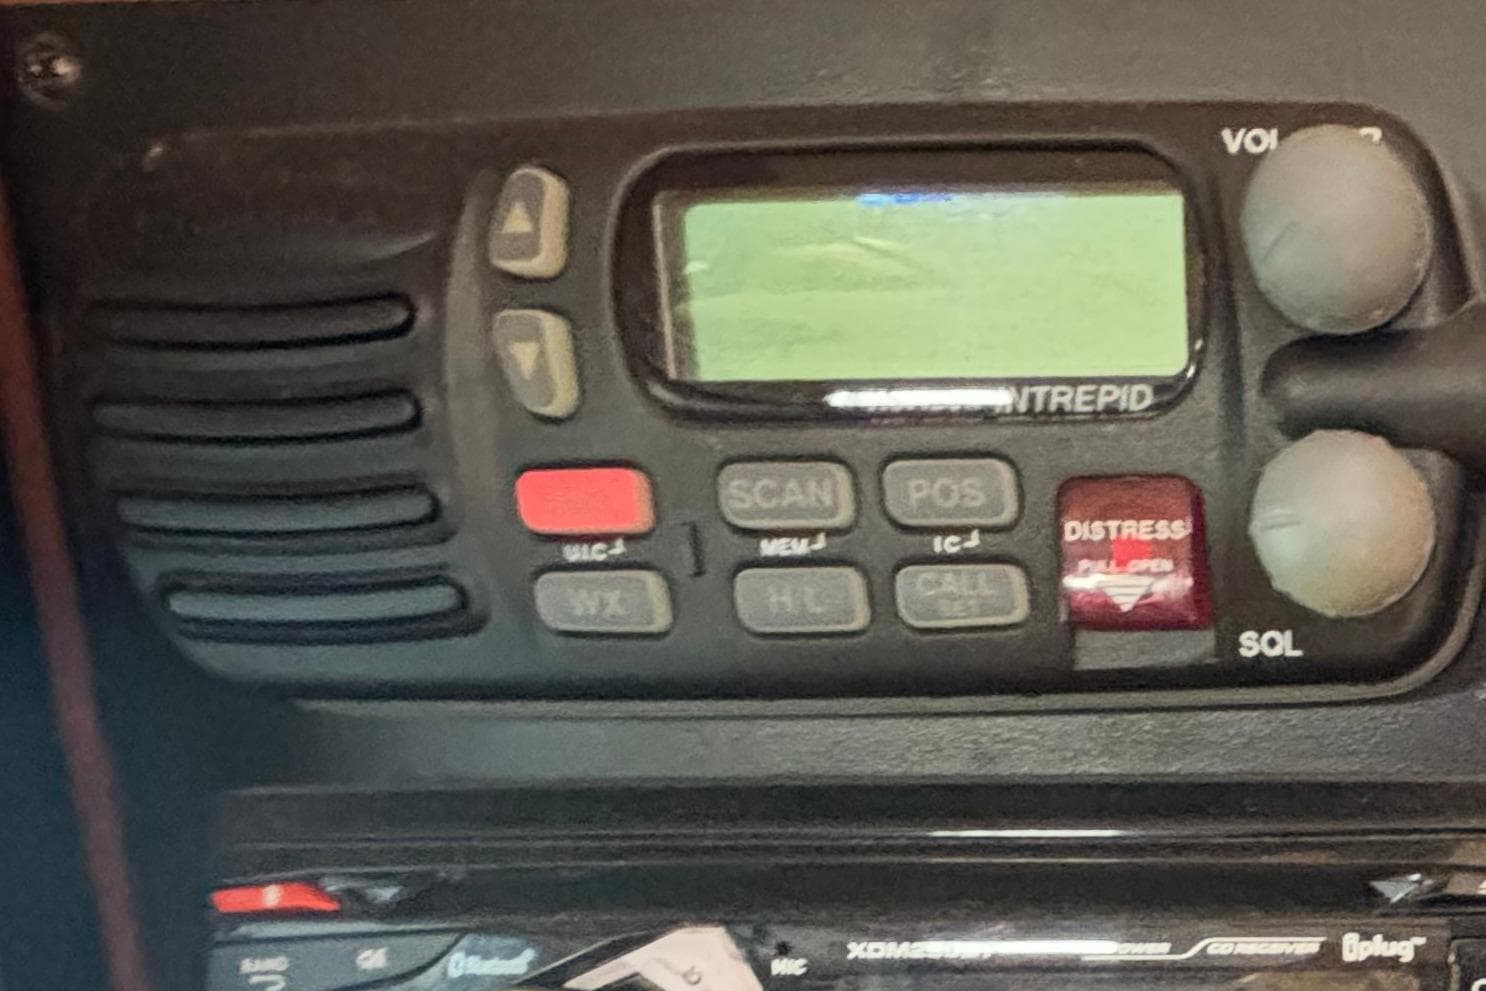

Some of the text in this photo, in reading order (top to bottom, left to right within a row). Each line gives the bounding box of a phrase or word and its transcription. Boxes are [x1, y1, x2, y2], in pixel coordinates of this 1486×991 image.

[729, 478, 833, 509] SCAN
[908, 478, 985, 508] POS
[1064, 519, 1189, 541] DISTRESS
[1238, 630, 1304, 659] SQL
